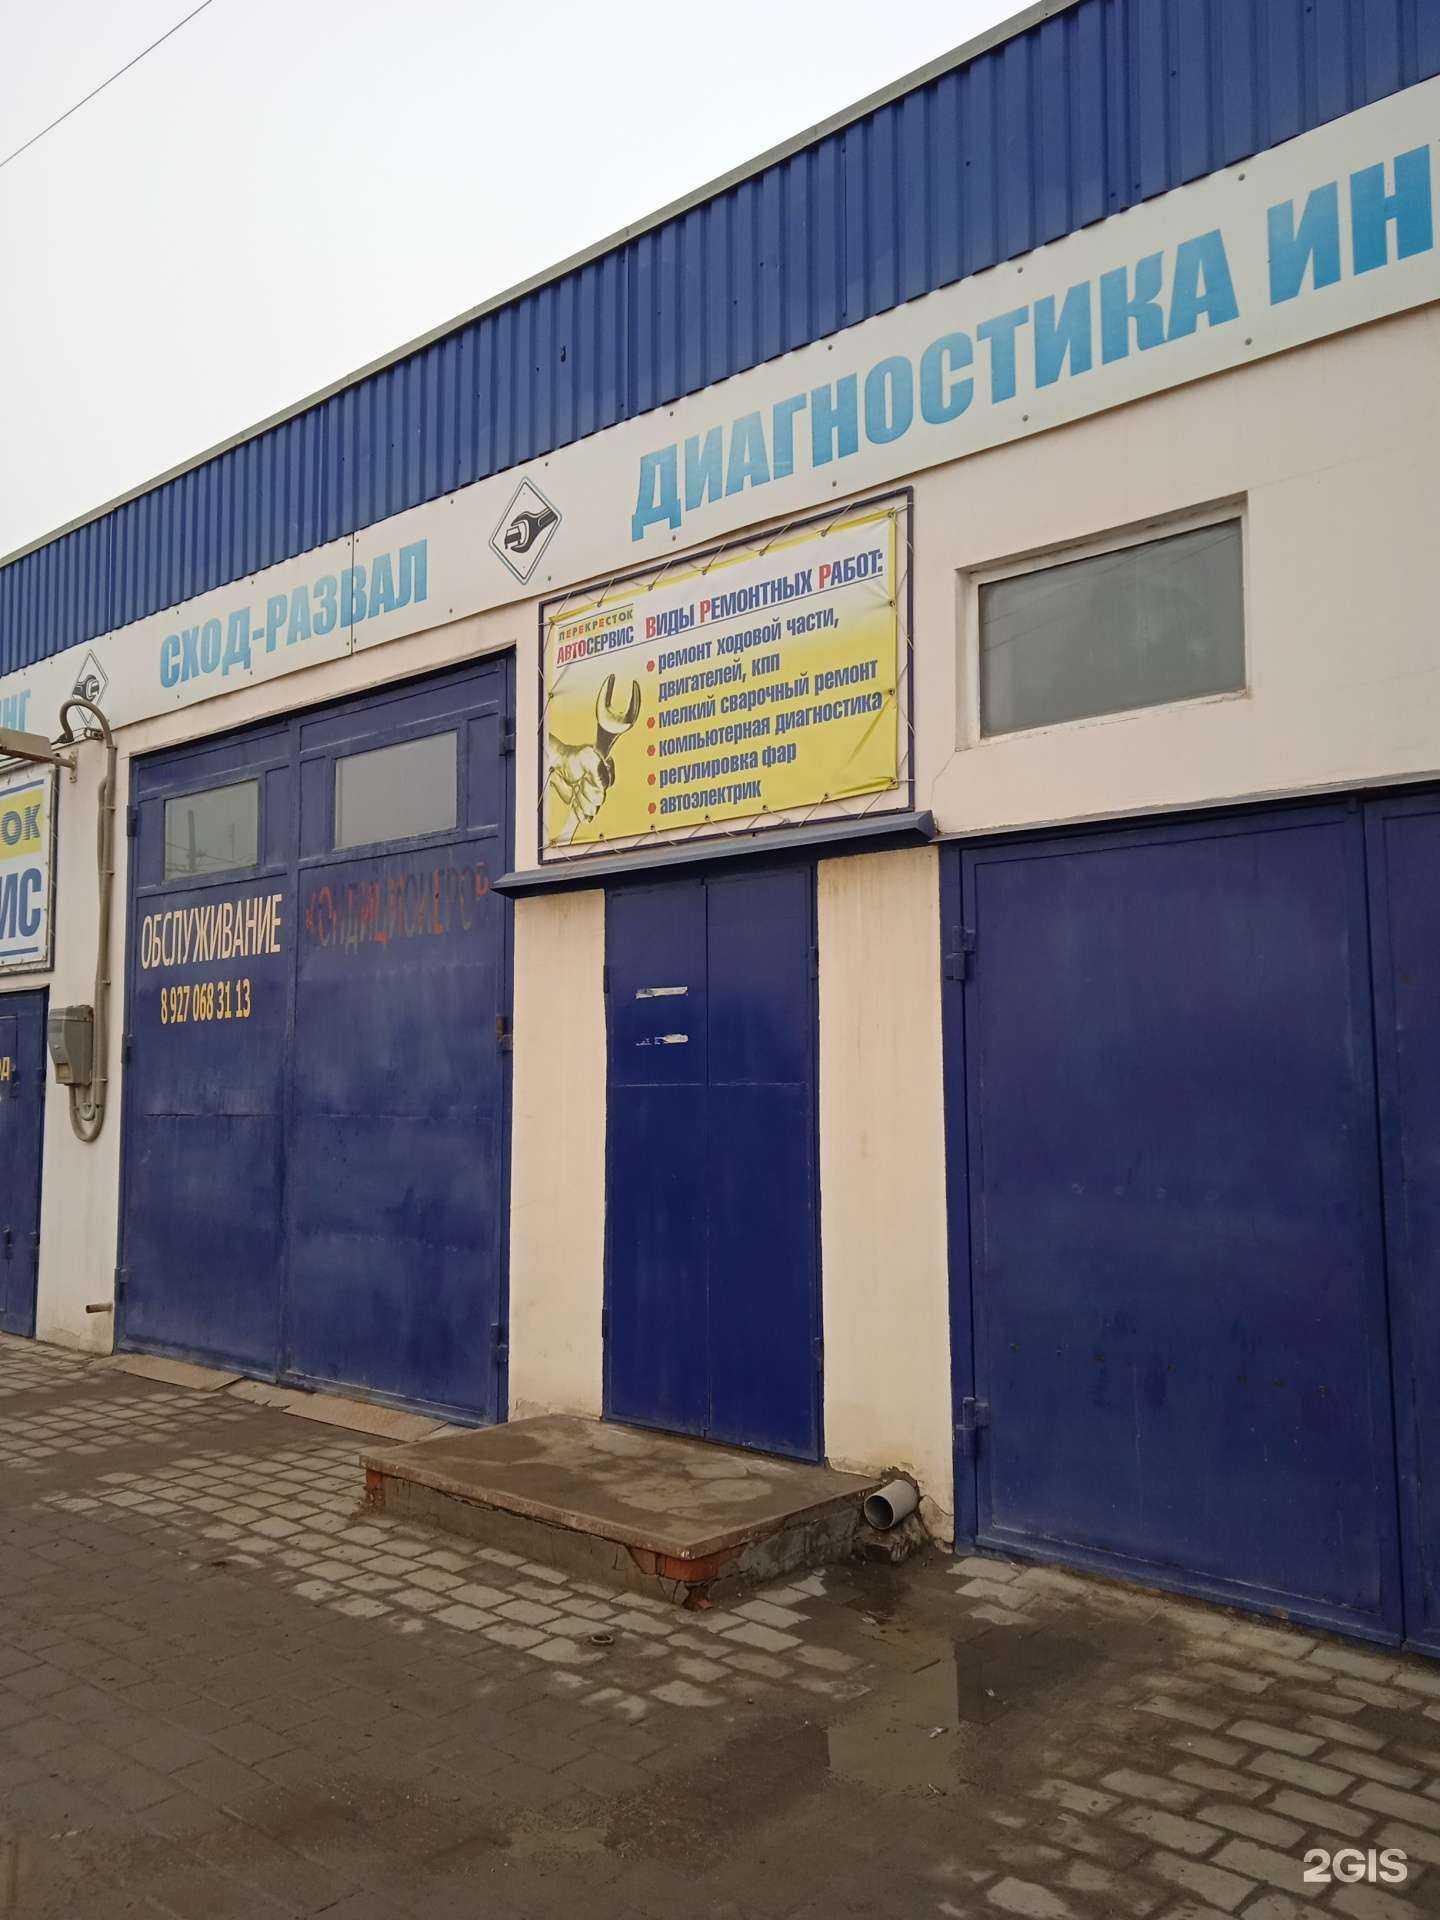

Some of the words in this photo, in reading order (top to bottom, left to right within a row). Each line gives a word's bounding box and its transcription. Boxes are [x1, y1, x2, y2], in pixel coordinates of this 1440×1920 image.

[631, 228, 1240, 542] ДИАГНОСТИКА
[1267, 143, 1434, 306] ИН
[159, 538, 428, 689] СХОД-РАЗВАЛ
[558, 609, 634, 641] ПЕРЕКРЕСТОК
[658, 641, 713, 675] ремонт
[716, 617, 782, 656] ходовой
[786, 608, 840, 637] части,
[556, 626, 634, 665] АВТОСЕРВИС
[658, 657, 747, 703] двигателей,
[658, 694, 716, 729] мелкий
[720, 671, 810, 712] сварочный
[814, 659, 878, 696] ремонт
[658, 717, 771, 758] компьютерная
[775, 691, 883, 736] диагностика
[659, 750, 759, 788] регулировка
[761, 742, 797, 768] фар
[660, 779, 762, 815] автоэлектрик
[141, 893, 283, 970] ОБСЛУЖИВАНИЕ
[160, 987, 168, 1025] 8
[170, 985, 191, 1024] 927
[192, 981, 214, 1022] 068
[216, 980, 232, 1020] 31
[235, 978, 251, 1018] 13
